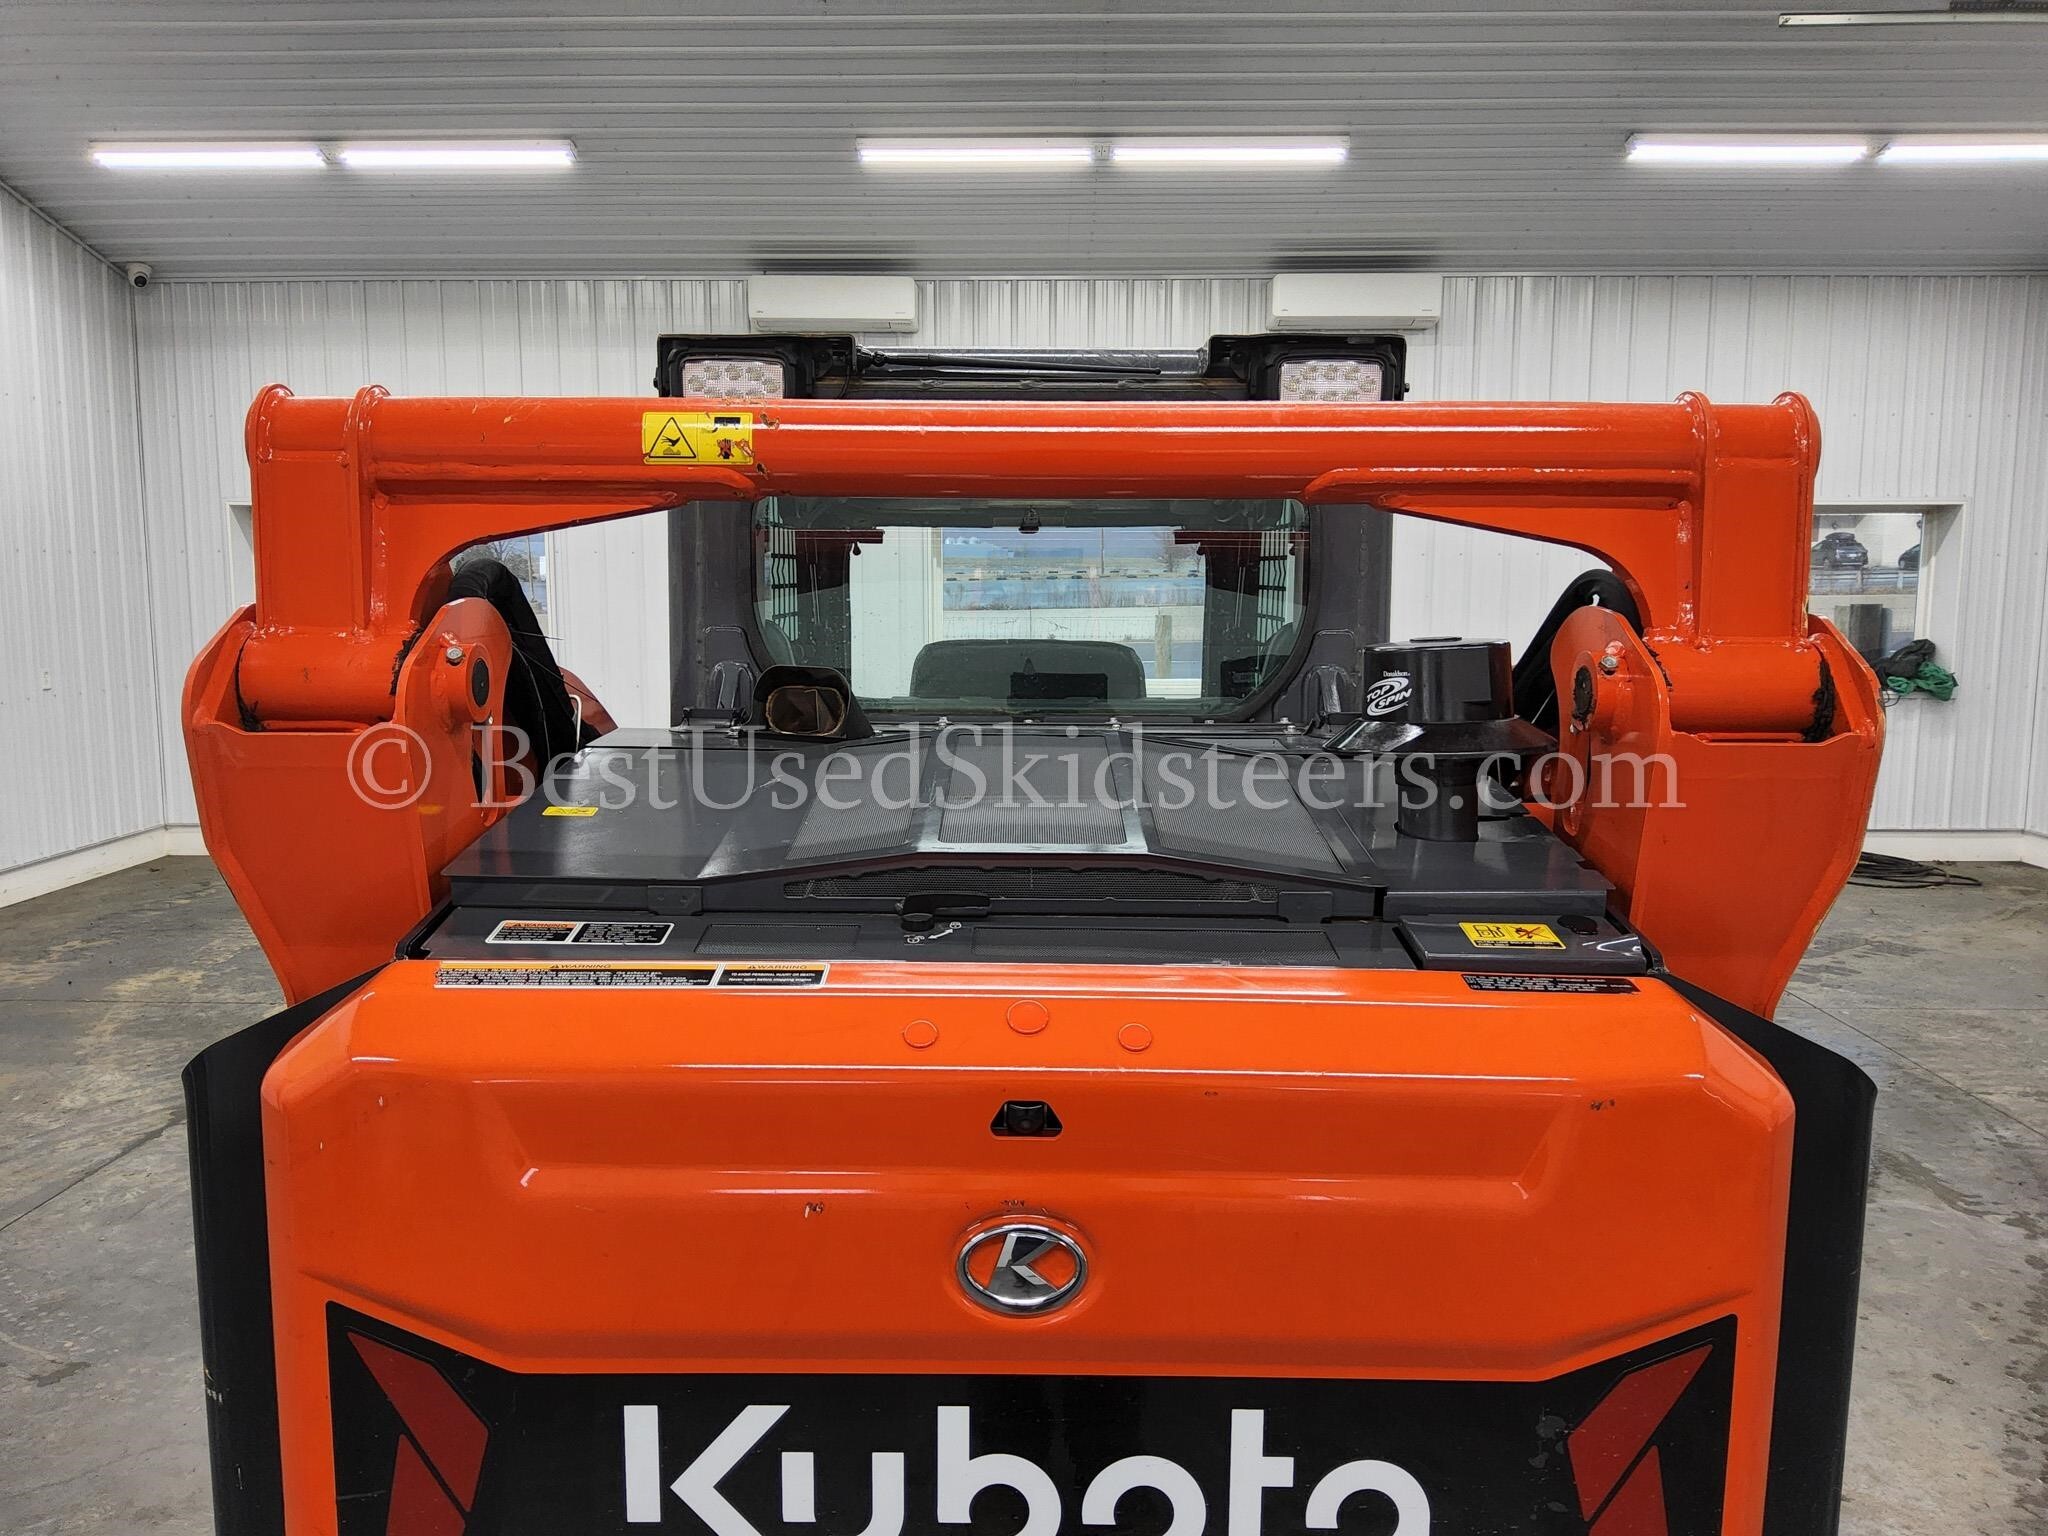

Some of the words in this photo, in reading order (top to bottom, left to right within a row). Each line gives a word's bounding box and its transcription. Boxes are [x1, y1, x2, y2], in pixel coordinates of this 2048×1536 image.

[1366, 685, 1391, 702] TOP
[1377, 688, 1412, 709] SPIN
[623, 1404, 1431, 1536] Kubota
